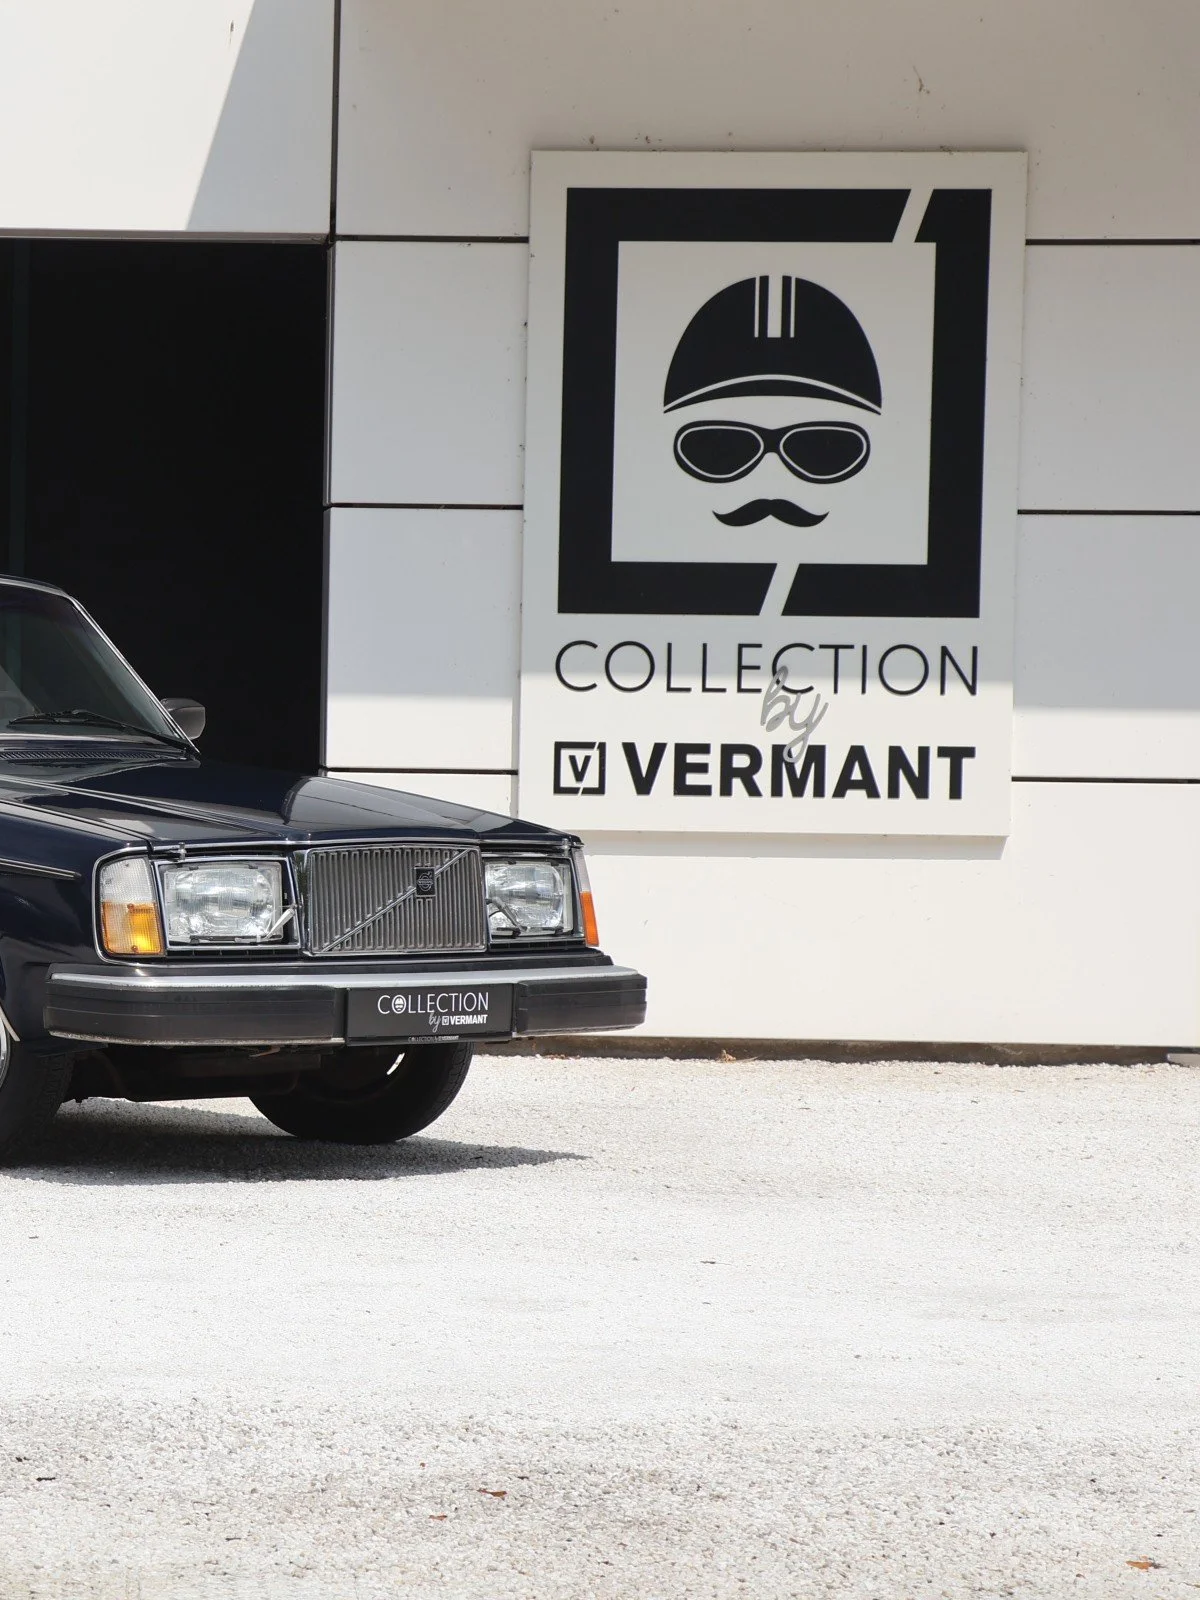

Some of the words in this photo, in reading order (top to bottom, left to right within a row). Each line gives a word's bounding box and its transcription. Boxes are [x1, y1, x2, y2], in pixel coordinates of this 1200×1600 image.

[555, 639, 978, 695] COLLECTION
[760, 665, 828, 763] by
[621, 741, 976, 800] VERMANT
[377, 991, 489, 1015] COLLECTION
[428, 1012, 441, 1033] by
[450, 1014, 488, 1026] VERMANT
